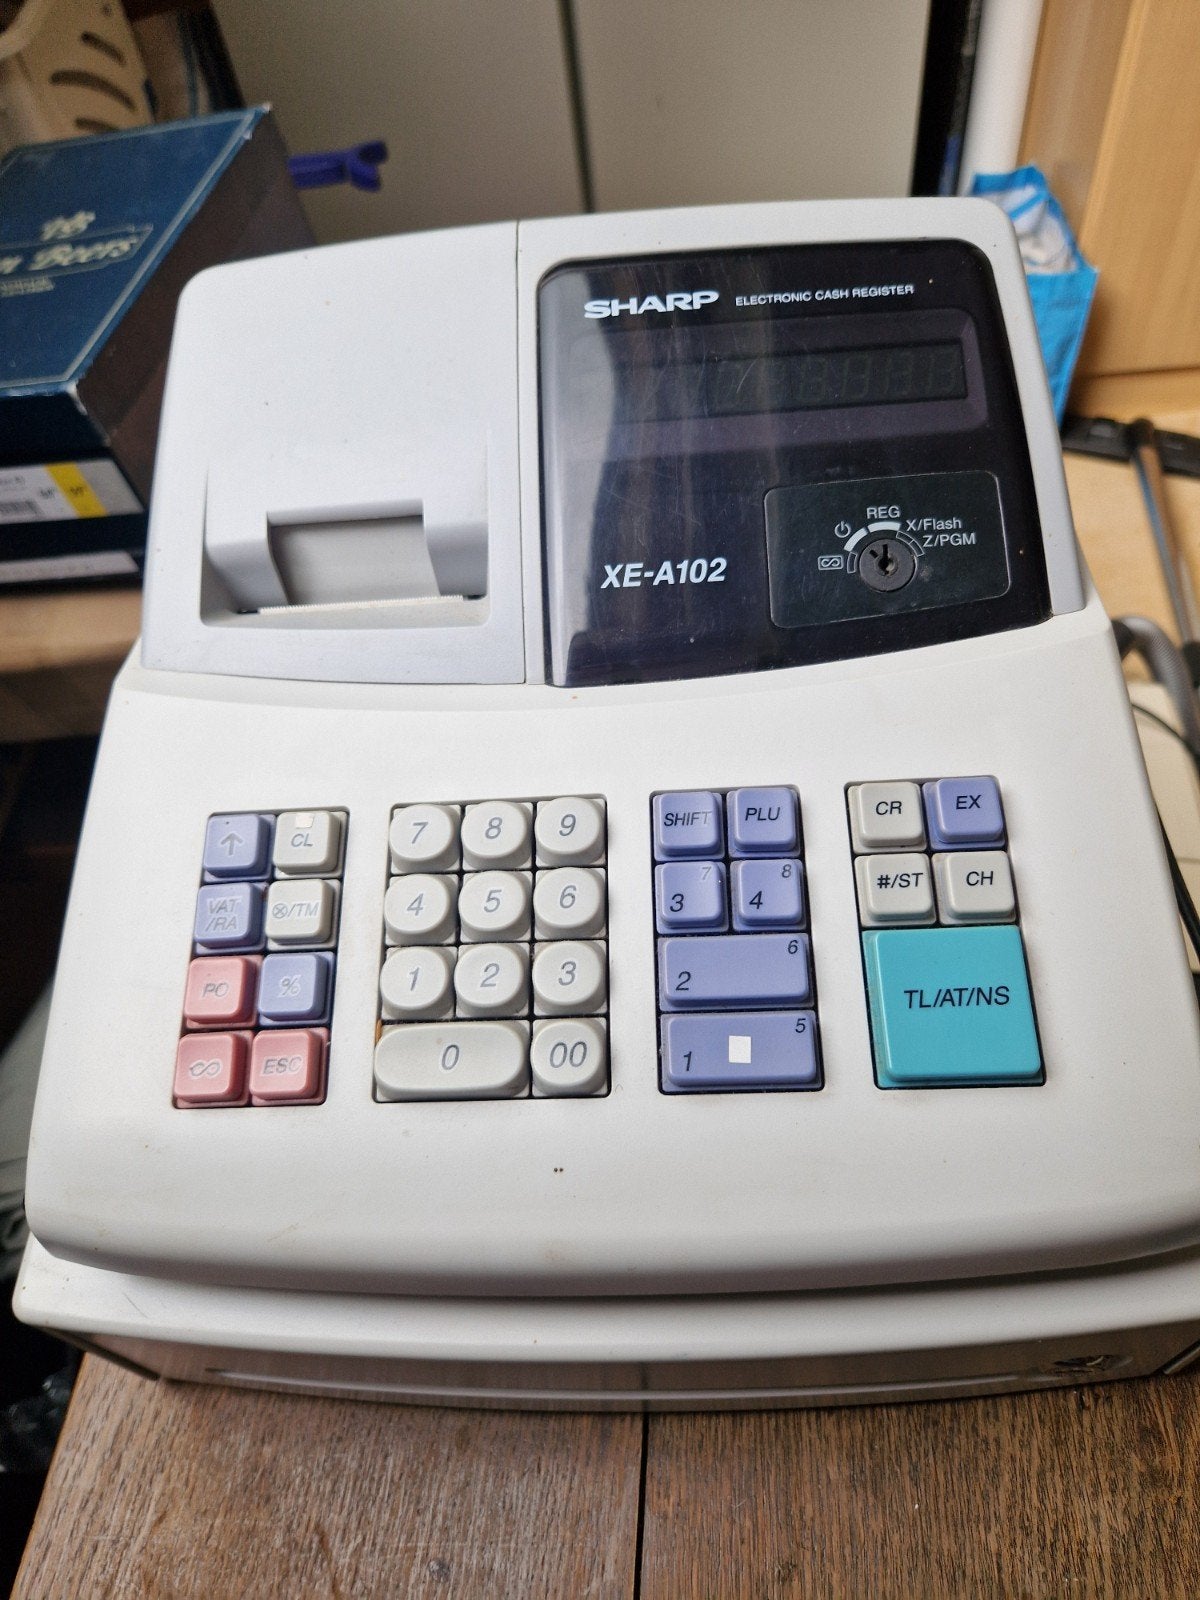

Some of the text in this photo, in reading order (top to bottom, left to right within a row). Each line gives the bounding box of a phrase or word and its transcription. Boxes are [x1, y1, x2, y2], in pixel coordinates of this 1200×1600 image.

[584, 291, 720, 319] SHARP
[735, 284, 915, 307] ELECTRONIC CASH REGISTER
[866, 506, 900, 519] REG
[906, 517, 962, 532] X/Flash
[922, 533, 976, 548] Z/PGM
[600, 557, 728, 589] XE-A102
[875, 801, 902, 815] CR
[956, 795, 981, 810] EX
[663, 810, 712, 826] SHIFT
[745, 807, 781, 821] PLU
[411, 821, 428, 844] 7
[484, 817, 503, 839] 8
[559, 814, 576, 836] 9
[290, 833, 314, 849] CL
[700, 866, 711, 880] 7
[782, 864, 792, 878] 8
[877, 872, 923, 889] #/ST
[966, 871, 994, 886] CH
[407, 893, 424, 916] 4
[484, 889, 502, 912] 5
[559, 885, 577, 908] 6
[670, 893, 684, 912] 3
[749, 891, 763, 910] 4
[208, 898, 240, 915] VAT
[787, 940, 798, 954] 6
[409, 967, 419, 991] 1
[480, 963, 500, 988] 2
[558, 961, 577, 986] 3
[675, 972, 691, 991] 2
[903, 986, 1010, 1009] TL/AT/NS
[795, 1018, 806, 1033] 5
[549, 1041, 588, 1068] 00
[683, 1051, 692, 1072] 1
[263, 1056, 302, 1075] ESC
